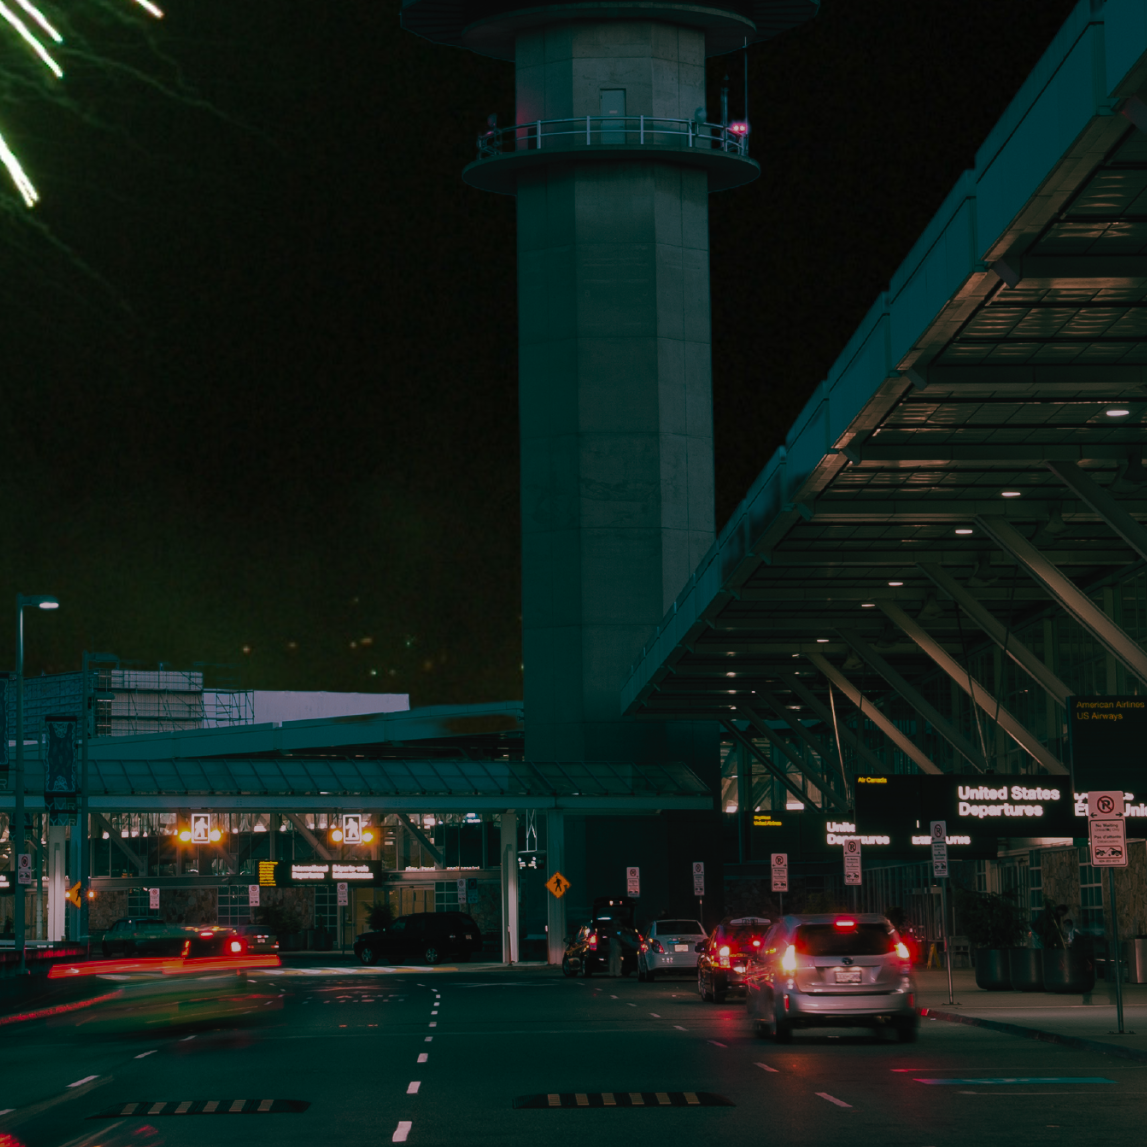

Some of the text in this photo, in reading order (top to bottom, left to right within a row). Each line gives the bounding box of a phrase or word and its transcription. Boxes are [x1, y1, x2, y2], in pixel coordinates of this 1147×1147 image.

[1076, 701, 1145, 709] American Airlines
[1077, 712, 1124, 722] US Airways
[958, 785, 1008, 801] United
[1011, 785, 1061, 801] States
[958, 801, 1044, 819] Departures
